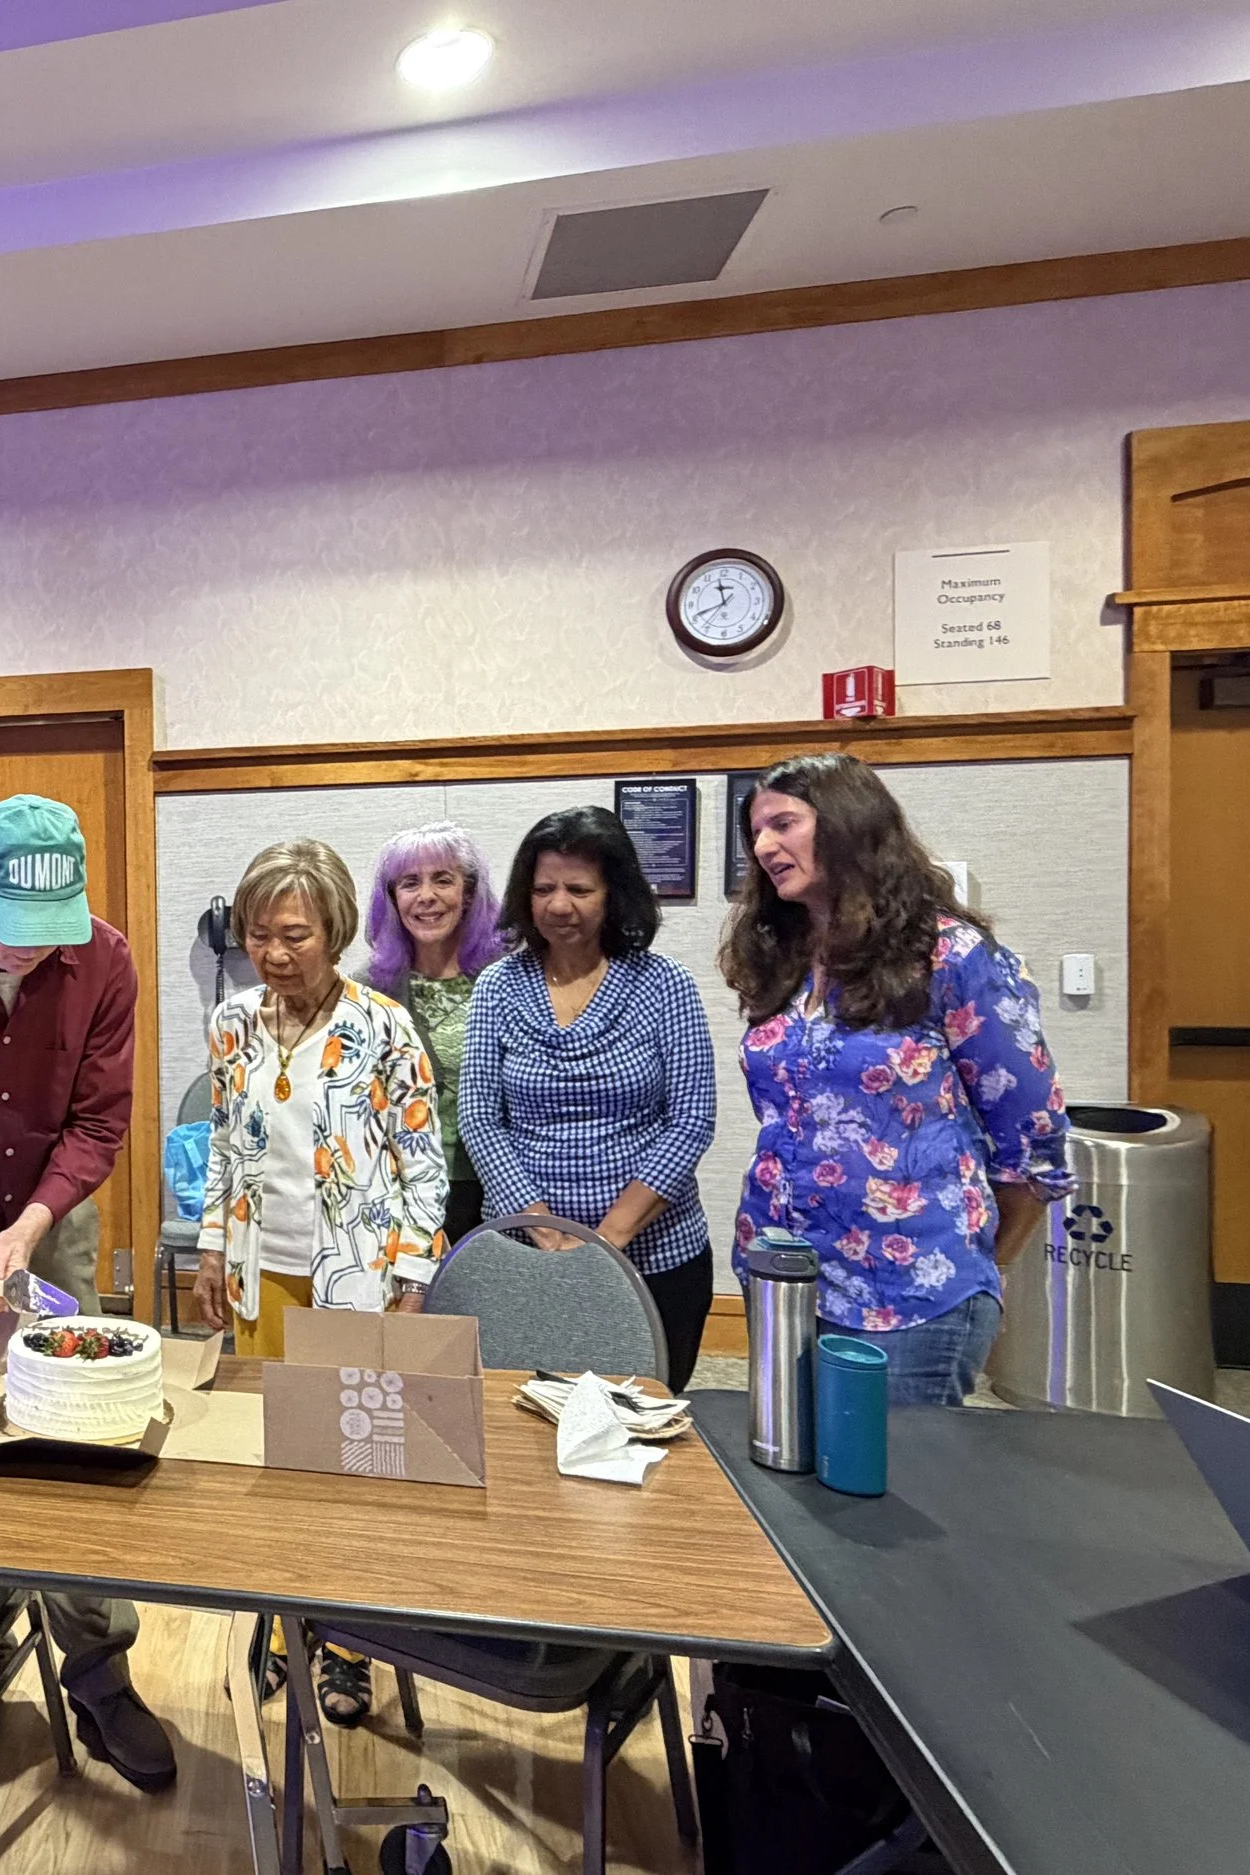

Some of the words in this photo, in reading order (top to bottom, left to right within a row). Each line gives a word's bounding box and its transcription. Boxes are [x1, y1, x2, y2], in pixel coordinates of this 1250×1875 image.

[941, 578, 1001, 589] Maximum
[937, 593, 1005, 605] Occupancy
[941, 621, 984, 634] Seated
[986, 620, 1001, 631] 68
[934, 637, 985, 649] Standing
[989, 635, 1010, 645] 146
[653, 785, 688, 793] CONDUCT
[8, 853, 76, 891] DUMONT
[1044, 1244, 1133, 1272] RECYCLE
